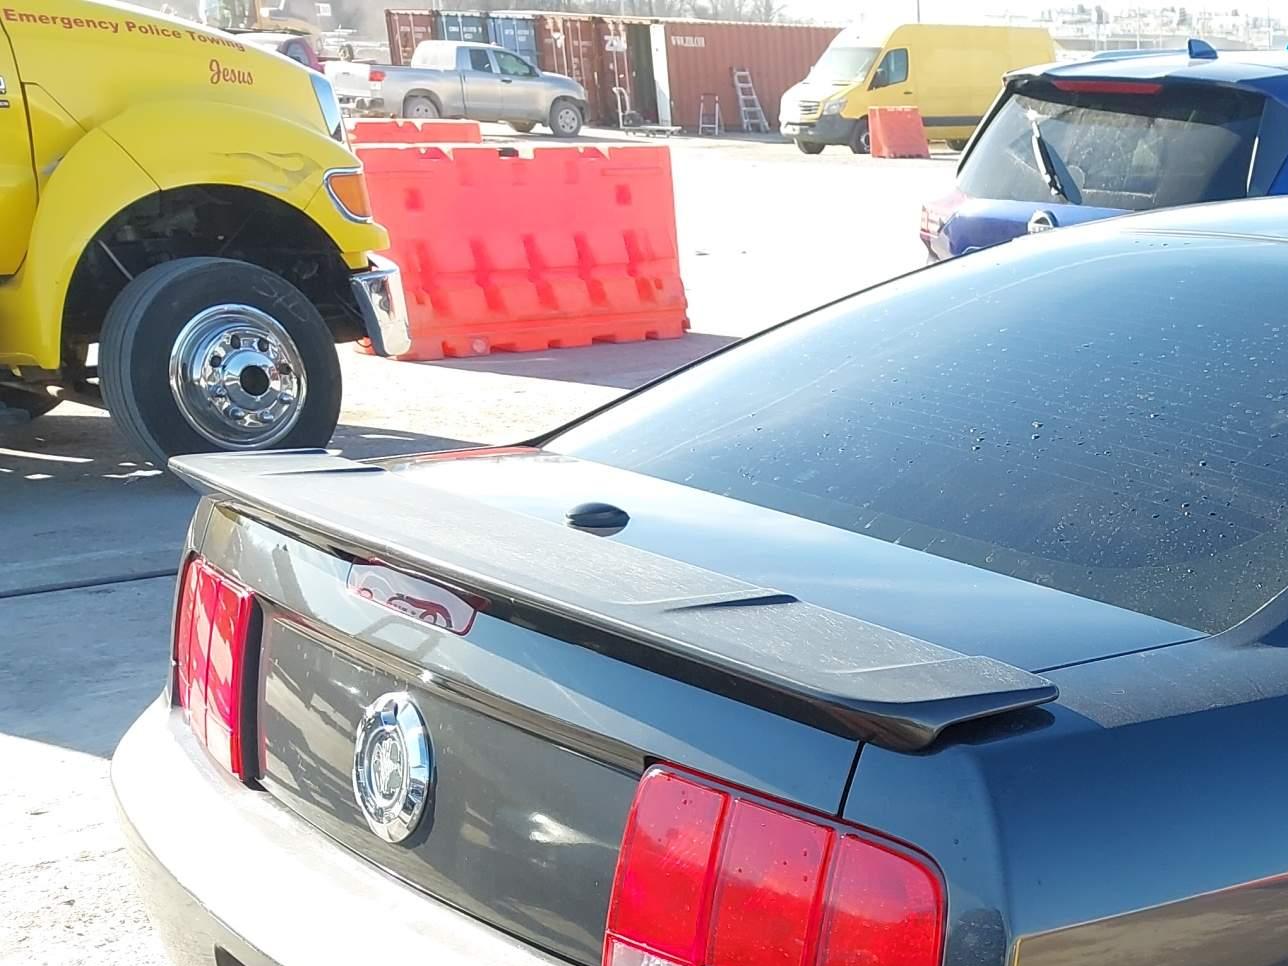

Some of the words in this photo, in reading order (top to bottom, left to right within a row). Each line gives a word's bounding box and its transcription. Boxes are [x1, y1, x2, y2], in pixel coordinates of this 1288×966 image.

[3, 8, 118, 33] Emergency
[125, 21, 182, 38] Police
[186, 30, 245, 52] Towing
[209, 59, 253, 85] Jesus
